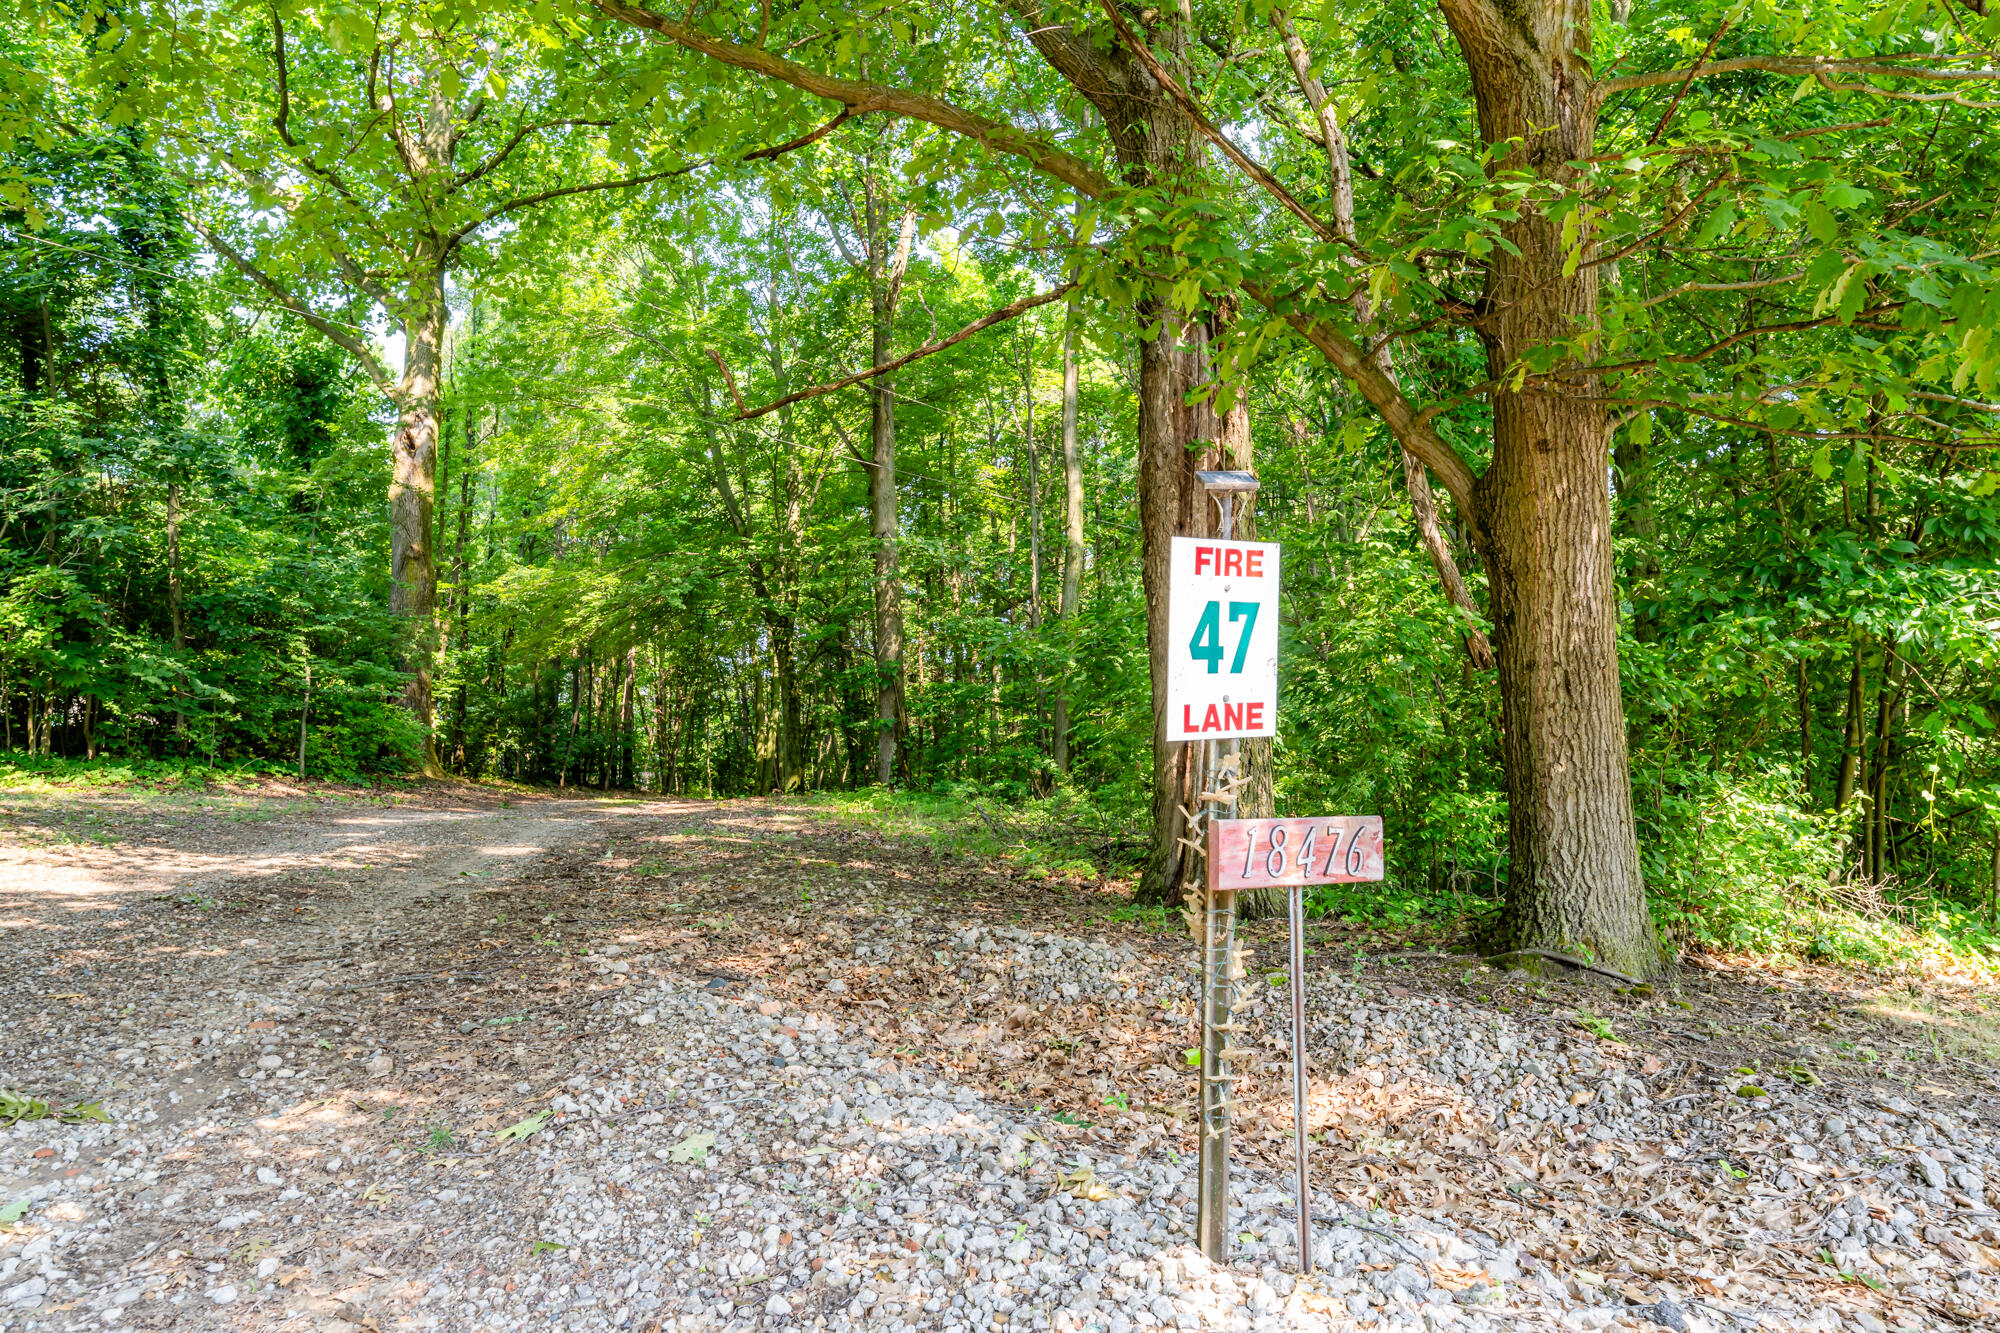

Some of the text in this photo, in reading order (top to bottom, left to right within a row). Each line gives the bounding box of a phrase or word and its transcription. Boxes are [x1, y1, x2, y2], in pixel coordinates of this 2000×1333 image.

[1194, 546, 1264, 578] FIRE
[1188, 600, 1261, 674] 47
[1183, 702, 1264, 733] LANE
[1242, 824, 1367, 879] 18476
